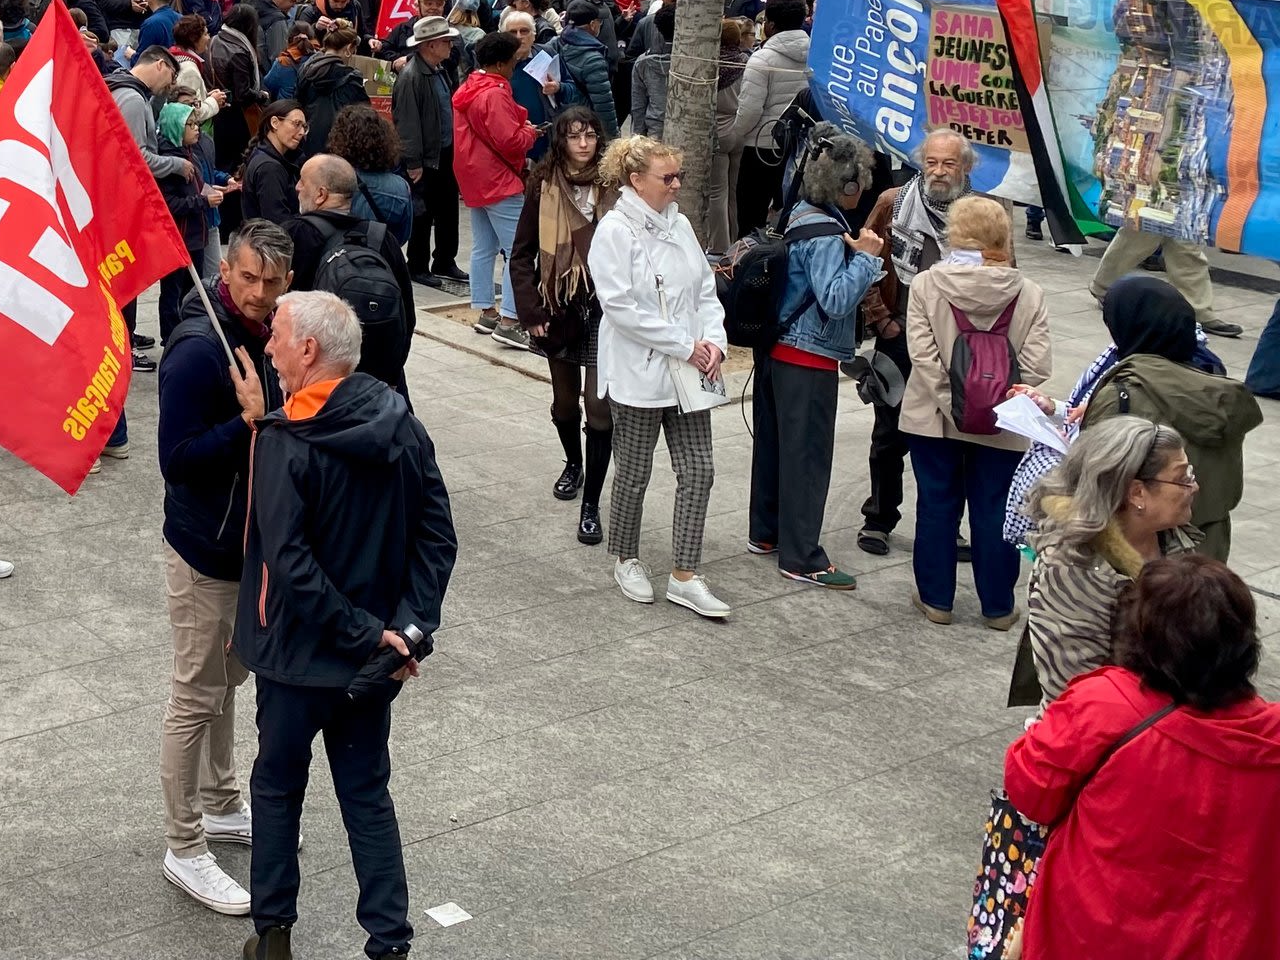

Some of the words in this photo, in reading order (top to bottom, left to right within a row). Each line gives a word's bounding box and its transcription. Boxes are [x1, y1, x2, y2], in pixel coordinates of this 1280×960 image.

[933, 35, 1011, 71] JEUNES
[856, 63, 879, 97] au
[931, 58, 980, 90] UNIE
[929, 81, 951, 98] LA
[951, 83, 1019, 111] GUERRE
